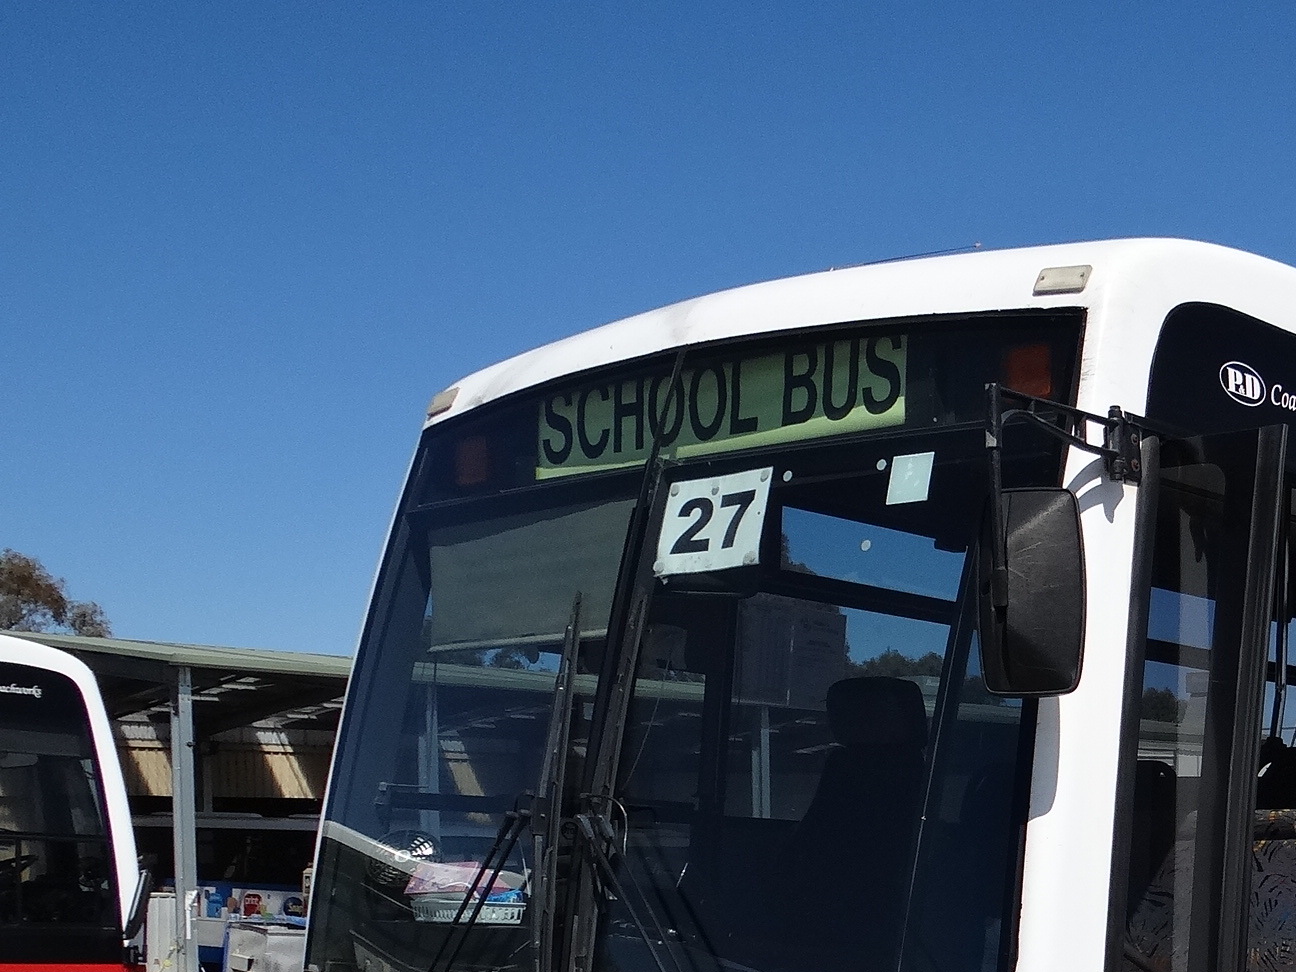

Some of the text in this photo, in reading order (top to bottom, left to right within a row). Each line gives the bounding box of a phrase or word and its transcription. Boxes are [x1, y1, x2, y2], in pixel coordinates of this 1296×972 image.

[542, 335, 901, 465] SCHOOL BUS
[669, 489, 756, 555] 27
